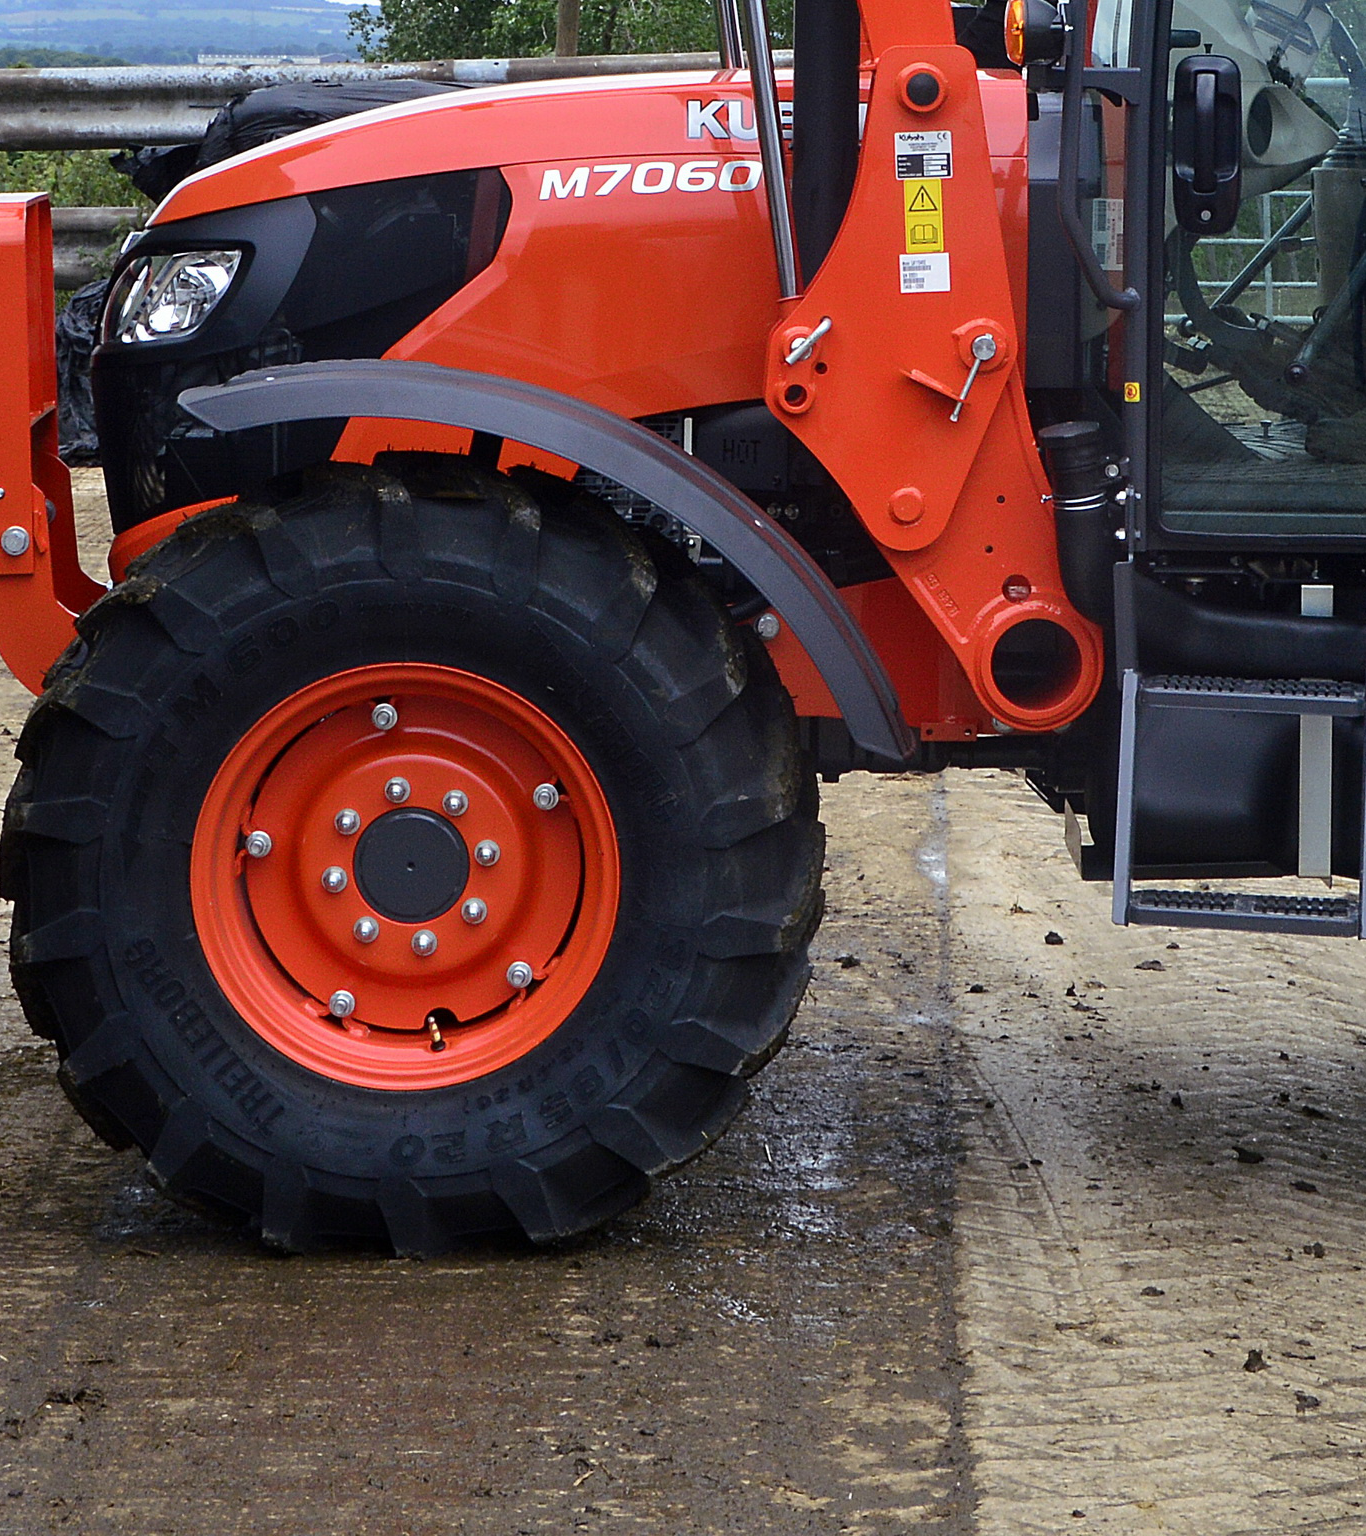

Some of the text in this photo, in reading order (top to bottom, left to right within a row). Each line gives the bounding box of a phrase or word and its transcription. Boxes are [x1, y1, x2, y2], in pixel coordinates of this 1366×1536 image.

[539, 160, 761, 200] M7060
[722, 438, 762, 465] HOT
[123, 940, 286, 1136] TRELLEBORG
